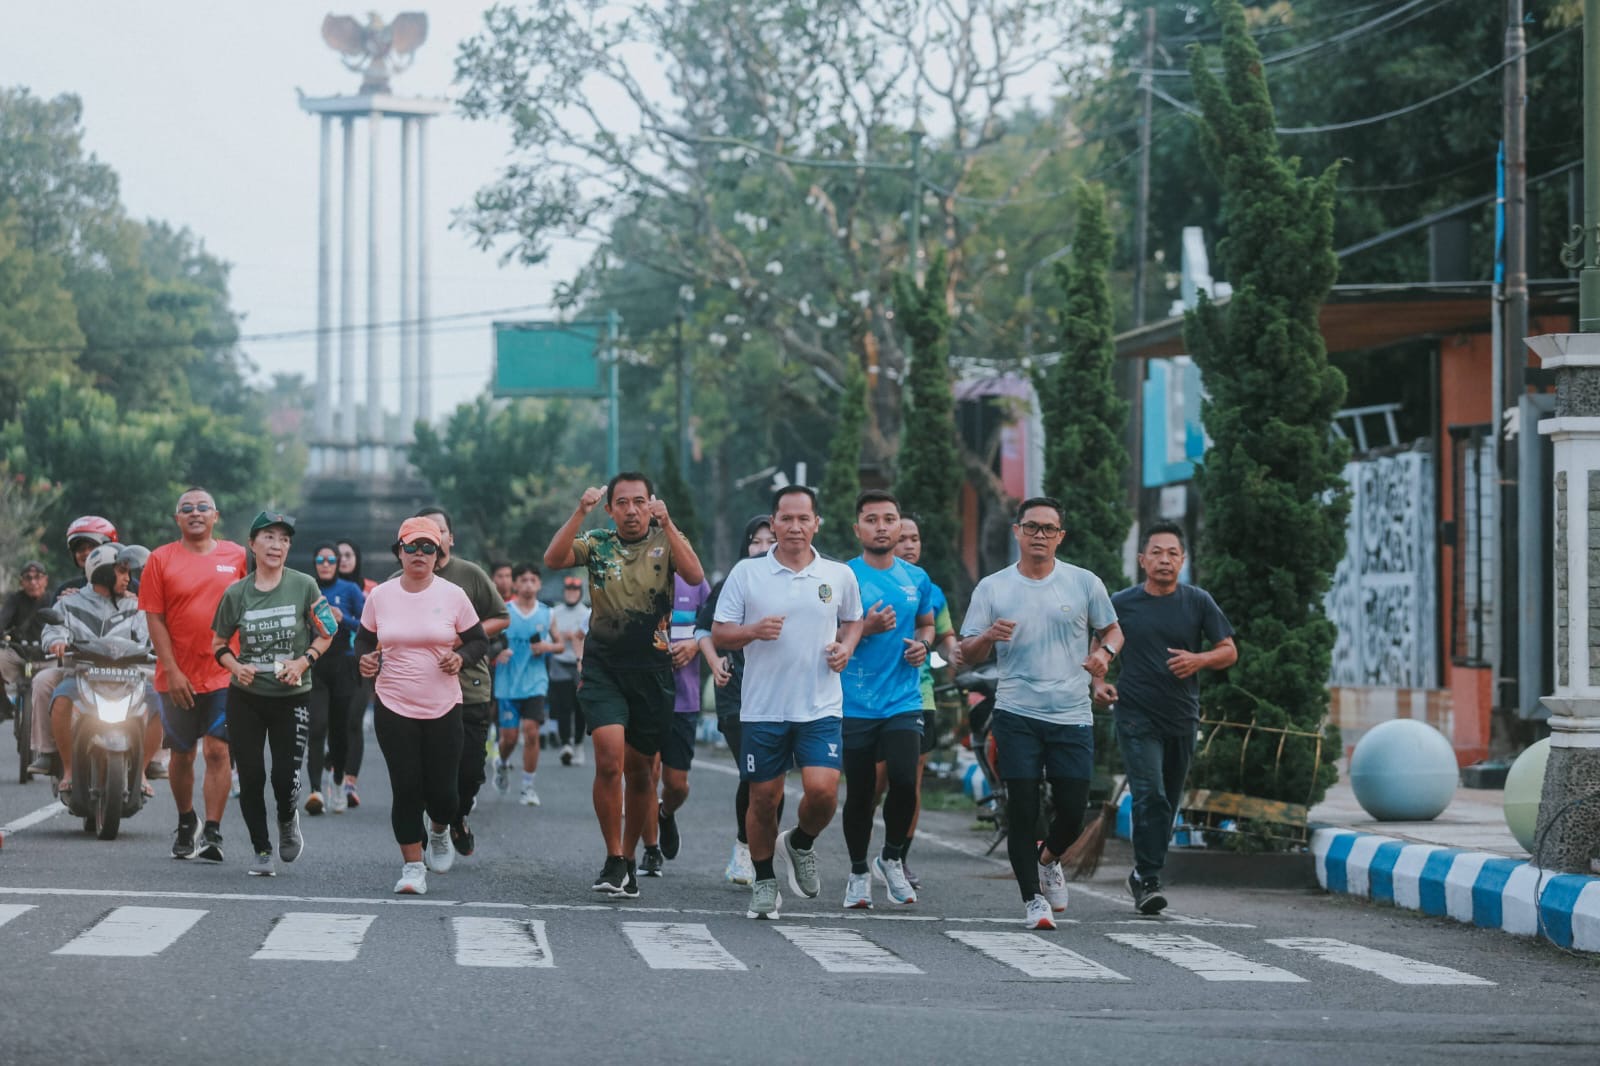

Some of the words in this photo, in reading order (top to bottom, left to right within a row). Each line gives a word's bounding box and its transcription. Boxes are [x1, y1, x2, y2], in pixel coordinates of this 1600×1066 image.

[246, 623, 256, 632] is
[259, 621, 279, 630] this
[258, 633, 273, 642] the
[276, 629, 296, 640] life
[746, 753, 756, 773] 8
